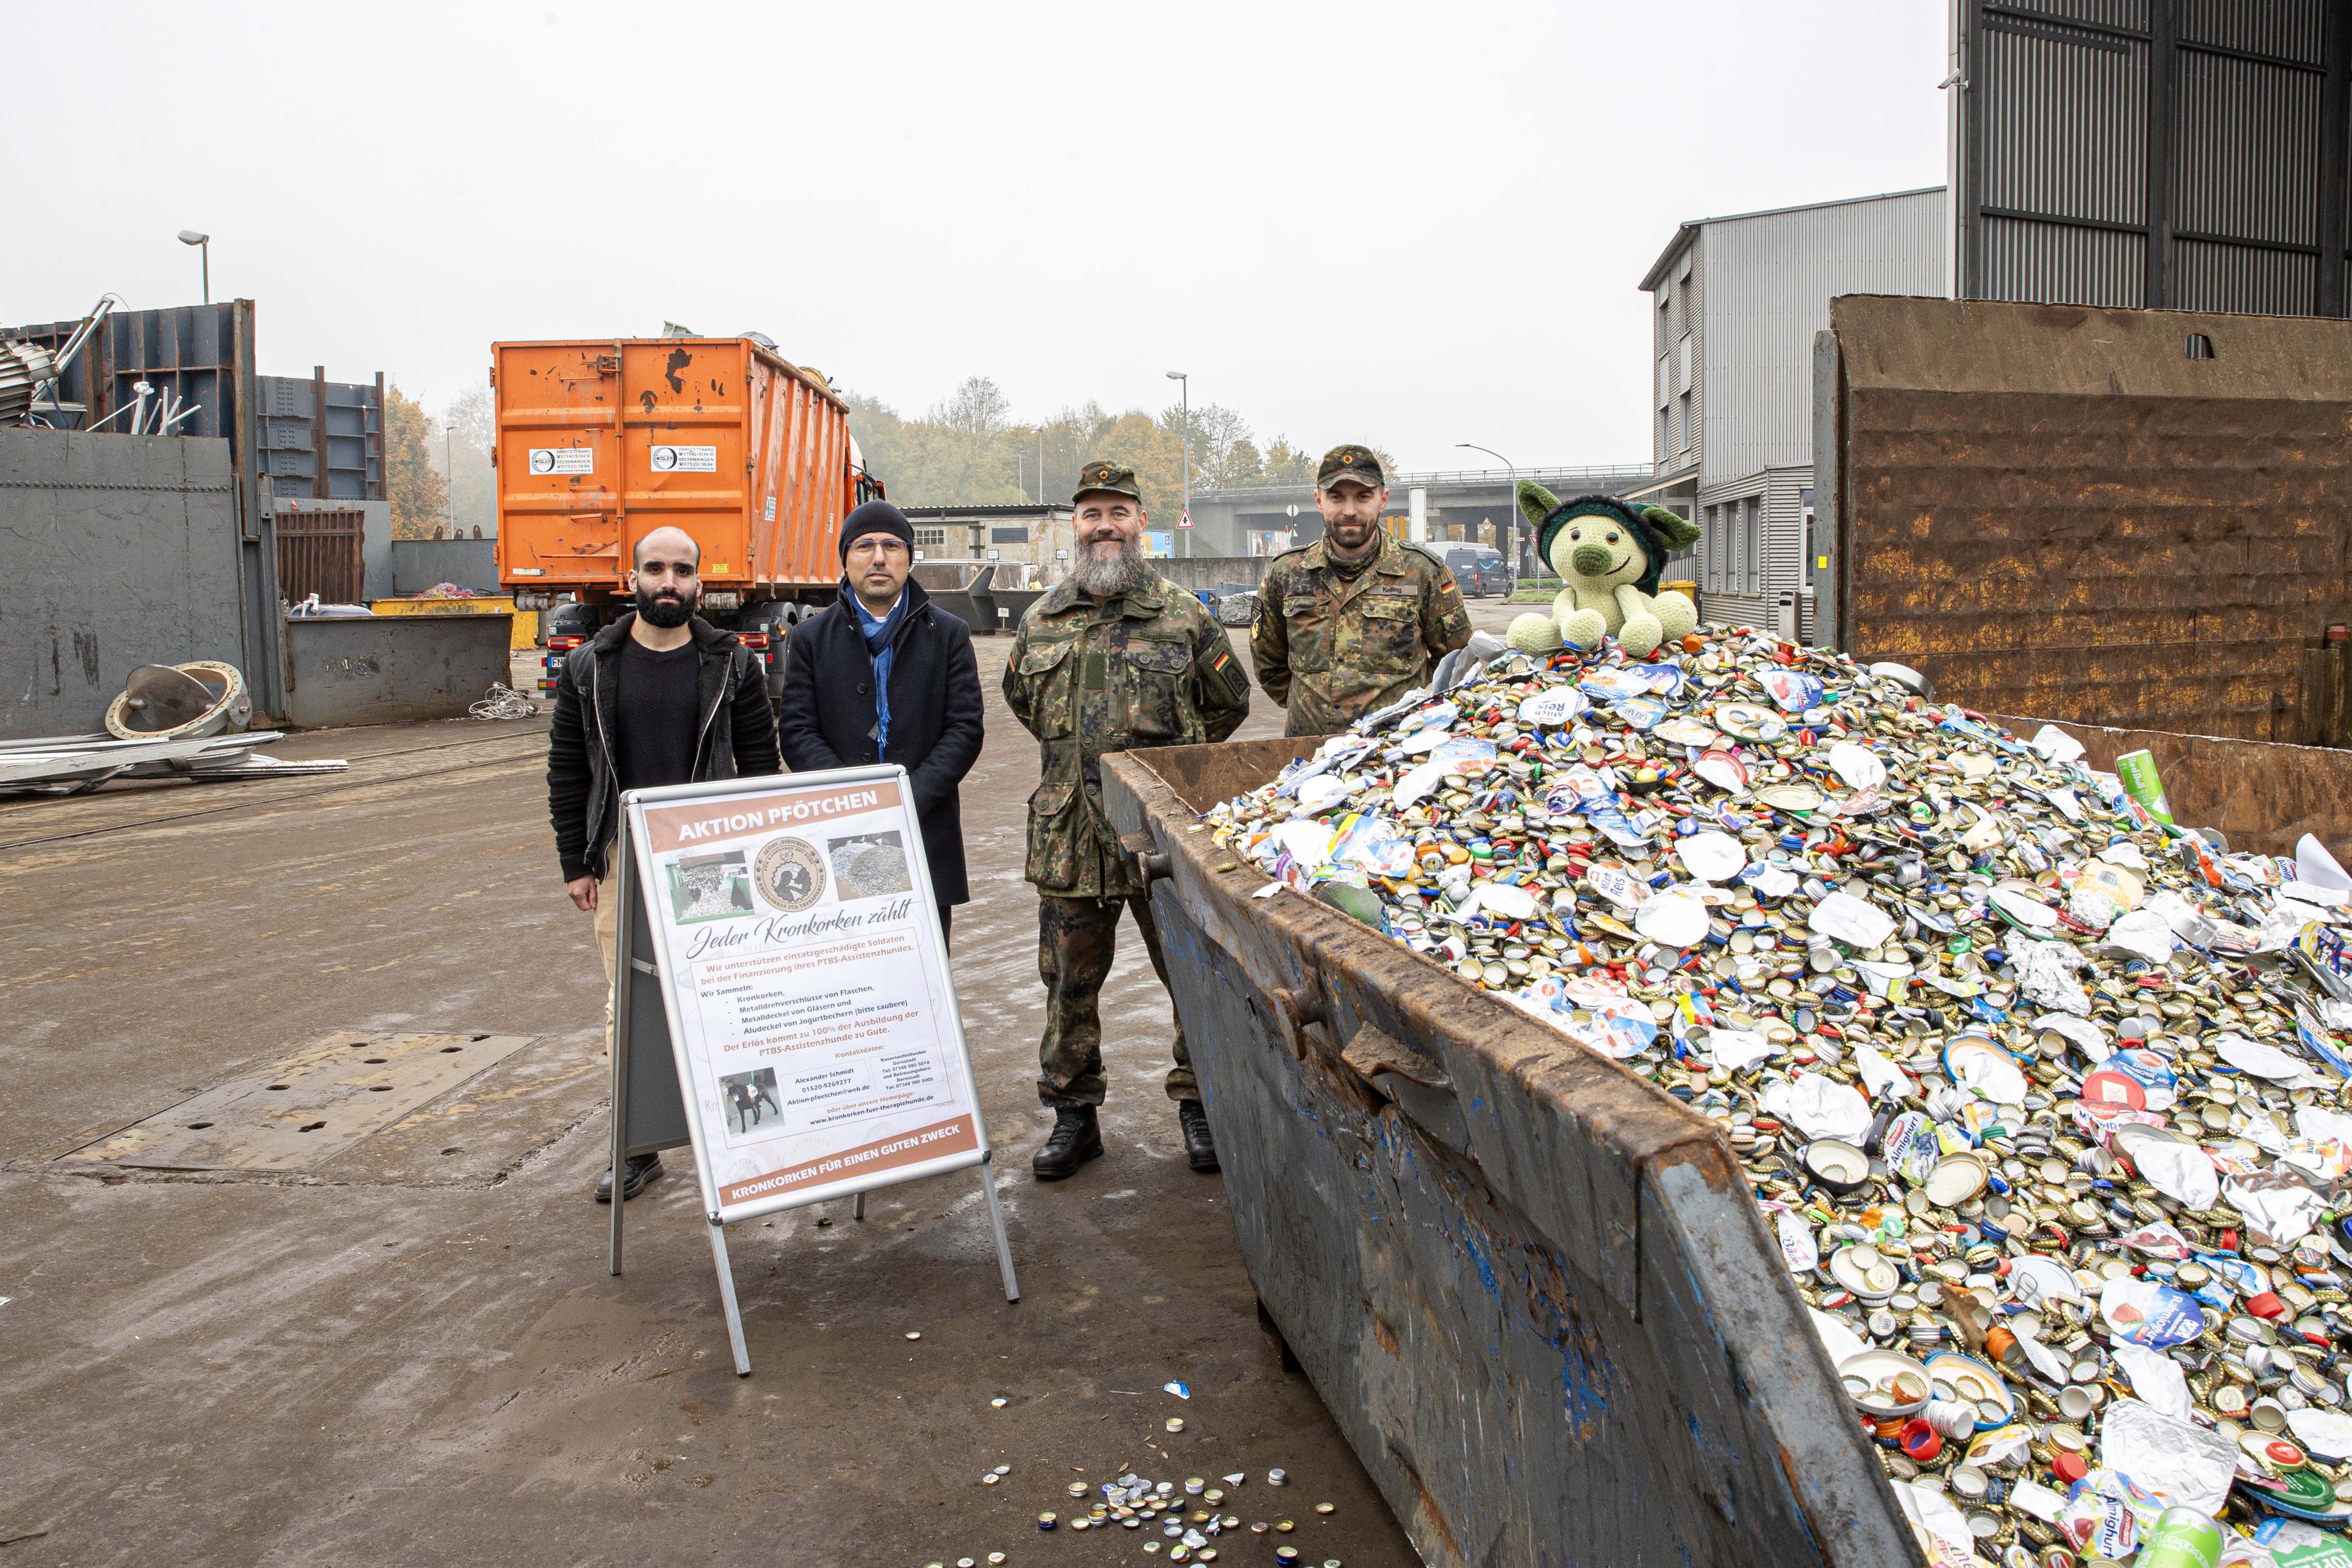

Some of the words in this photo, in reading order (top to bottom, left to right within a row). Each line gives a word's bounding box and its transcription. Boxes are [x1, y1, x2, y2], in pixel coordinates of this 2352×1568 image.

[1534, 709, 1564, 718] Milch
[1536, 703, 1566, 712] Reis
[2128, 758, 2141, 774] Red
[2133, 773, 2146, 789] Bull
[678, 811, 764, 841] AKTION
[769, 790, 878, 824] PFÖTCHEN
[1600, 872, 1613, 891] Milch
[2278, 859, 2294, 882] Almigh
[1610, 877, 1626, 898] Reis
[686, 925, 748, 959] Jeder
[754, 909, 863, 943] Kronkorken
[867, 898, 921, 924] zählt
[701, 977, 714, 985] bei
[717, 974, 732, 982] der
[734, 965, 793, 980] Finanzierung
[794, 961, 815, 970] ihres
[817, 945, 915, 966] PTBS-Assistenzhundes.
[706, 963, 722, 973] Wir
[725, 955, 781, 970] unterstützen
[783, 942, 866, 961] einsatzgeschädigte
[868, 935, 905, 947] Soldaten
[701, 990, 714, 998] Wir
[715, 984, 754, 996] Sammeln:
[737, 990, 786, 1003] Kronkorken,
[739, 994, 823, 1014] Metalldrehverschlüsse
[840, 985, 875, 996] Flaschen,
[741, 1011, 790, 1024] Metalldeckel
[807, 1002, 835, 1013] Gläsern
[743, 1021, 782, 1035] Aludeckel
[799, 1009, 854, 1026] Jogurtbechern
[855, 1004, 875, 1016] (bitte
[876, 999, 908, 1010] saubere)
[724, 1043, 740, 1052] Der
[742, 1038, 764, 1049] Erlös
[766, 1033, 798, 1044] kommt
[799, 1030, 810, 1038] zu
[812, 1025, 837, 1036] 100%
[838, 1021, 853, 1031] der
[854, 1013, 904, 1029] Ausbildung
[905, 1010, 919, 1018] der
[759, 1034, 853, 1057] PTBS-Assistenzhunde
[866, 1027, 891, 1036] Gute.
[835, 1045, 885, 1059] Kontaktdaten:
[881, 1050, 927, 1062] Kasernenfeldwebel
[795, 1074, 828, 1084] Alexander
[829, 1068, 854, 1078] Schmidt
[893, 1066, 931, 1077] Betreuungsbüro
[788, 1084, 870, 1106] Aktion-pfoetchen@web.de
[802, 1078, 851, 1093] 01520-9269277
[809, 1095, 934, 1126] www.kronkorken-fuer-therapiehunde.de
[842, 1103, 857, 1111] über
[858, 1099, 879, 1108] unsere
[880, 1091, 915, 1103] Homepage:
[1887, 1121, 1903, 1147] Ehrmann
[1891, 1116, 1918, 1165] Almighurt
[731, 1167, 818, 1199] KRONKORKEN
[818, 1158, 843, 1175] FÜR
[844, 1149, 880, 1167] EINEN
[880, 1136, 918, 1156] GUTEN
[921, 1124, 961, 1144] ZWECK
[2143, 1295, 2184, 1345] Rahmjoghurt
[2103, 1495, 2119, 1559] Almighurt
